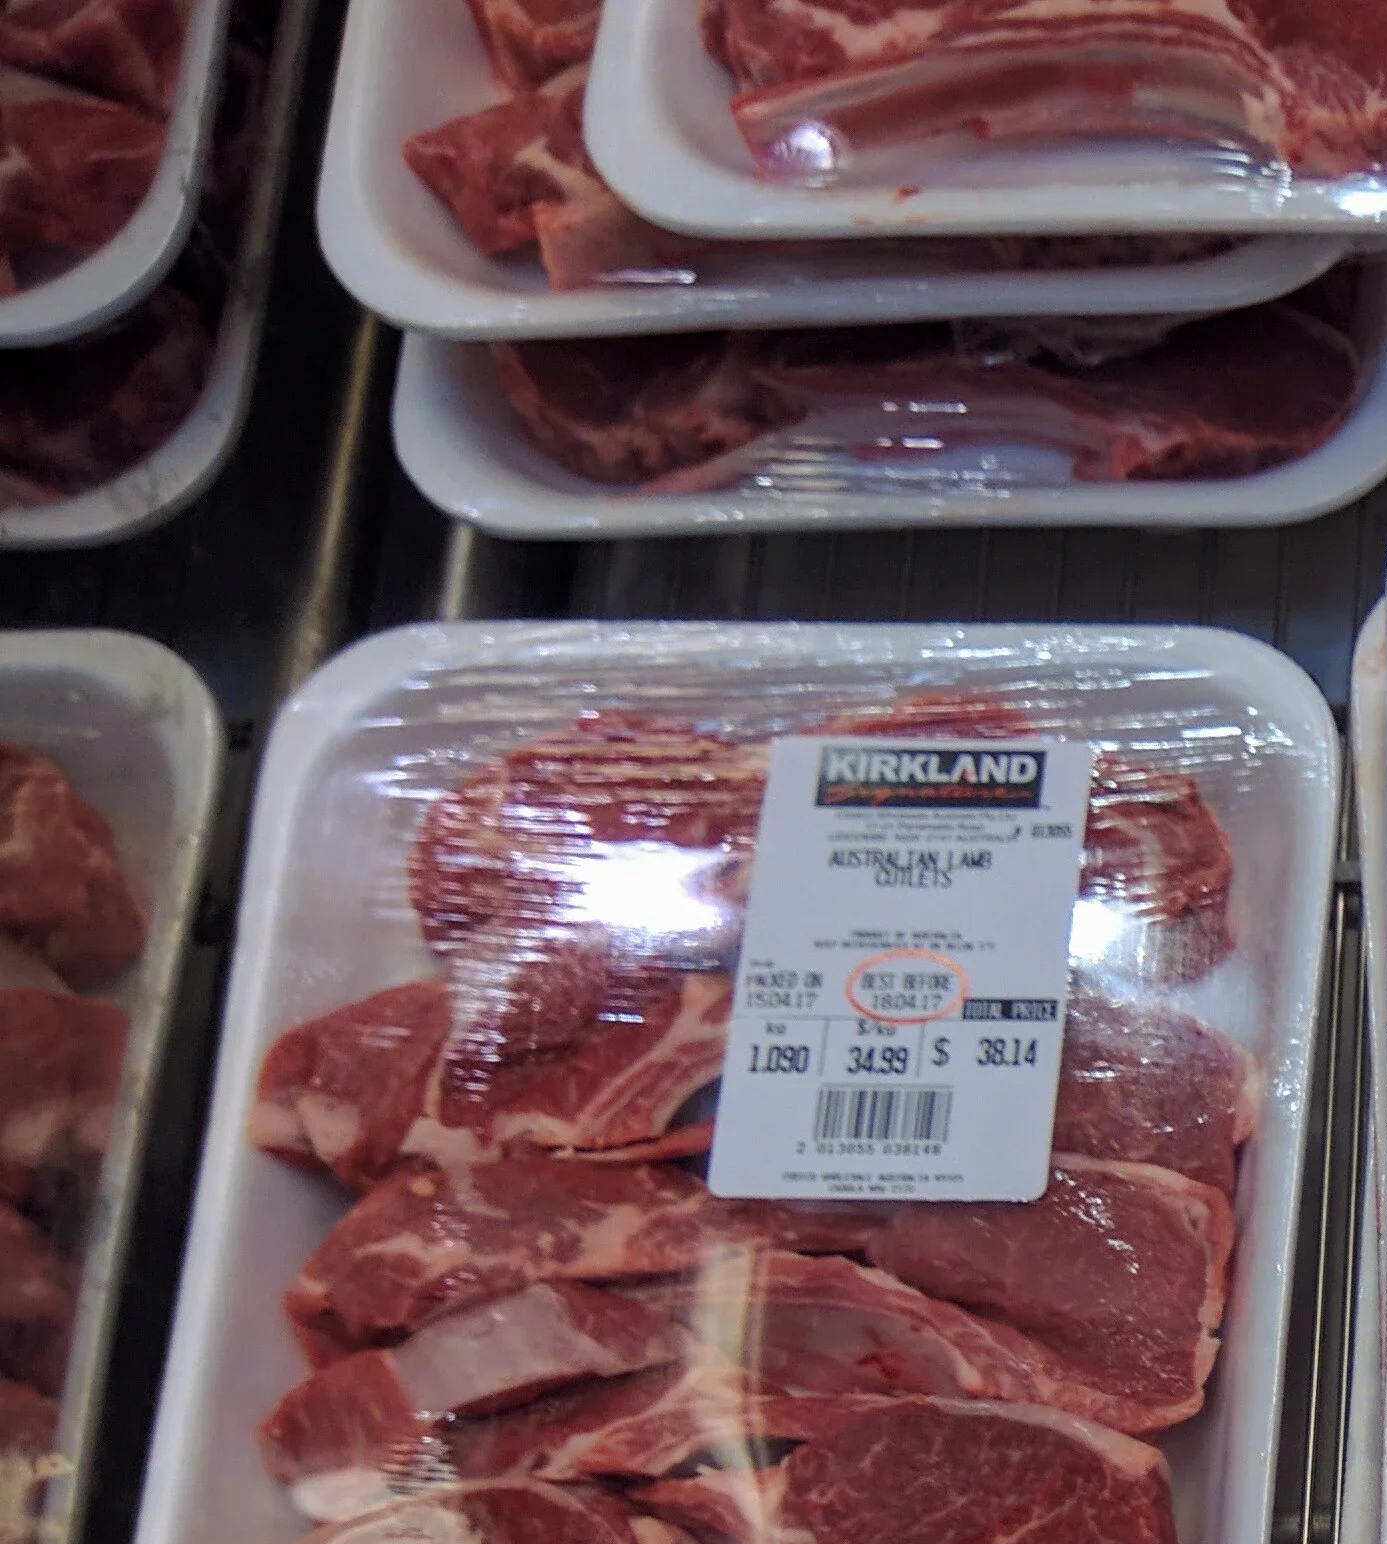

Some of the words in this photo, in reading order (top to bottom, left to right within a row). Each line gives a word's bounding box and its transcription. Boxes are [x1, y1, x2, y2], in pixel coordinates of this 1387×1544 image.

[825, 752, 1038, 783] KIRKLAND
[829, 849, 938, 869] AUSTRALIAN
[947, 851, 992, 869] LAMB
[875, 868, 952, 887] CUTLETS
[861, 972, 895, 990] BEST
[903, 973, 952, 991] BEFORE
[871, 993, 942, 1009] 18.04.17
[749, 1045, 810, 1073] 1.090
[848, 1047, 908, 1075] 34.99
[933, 1038, 950, 1066] $
[977, 1038, 1038, 1066] 38.14
